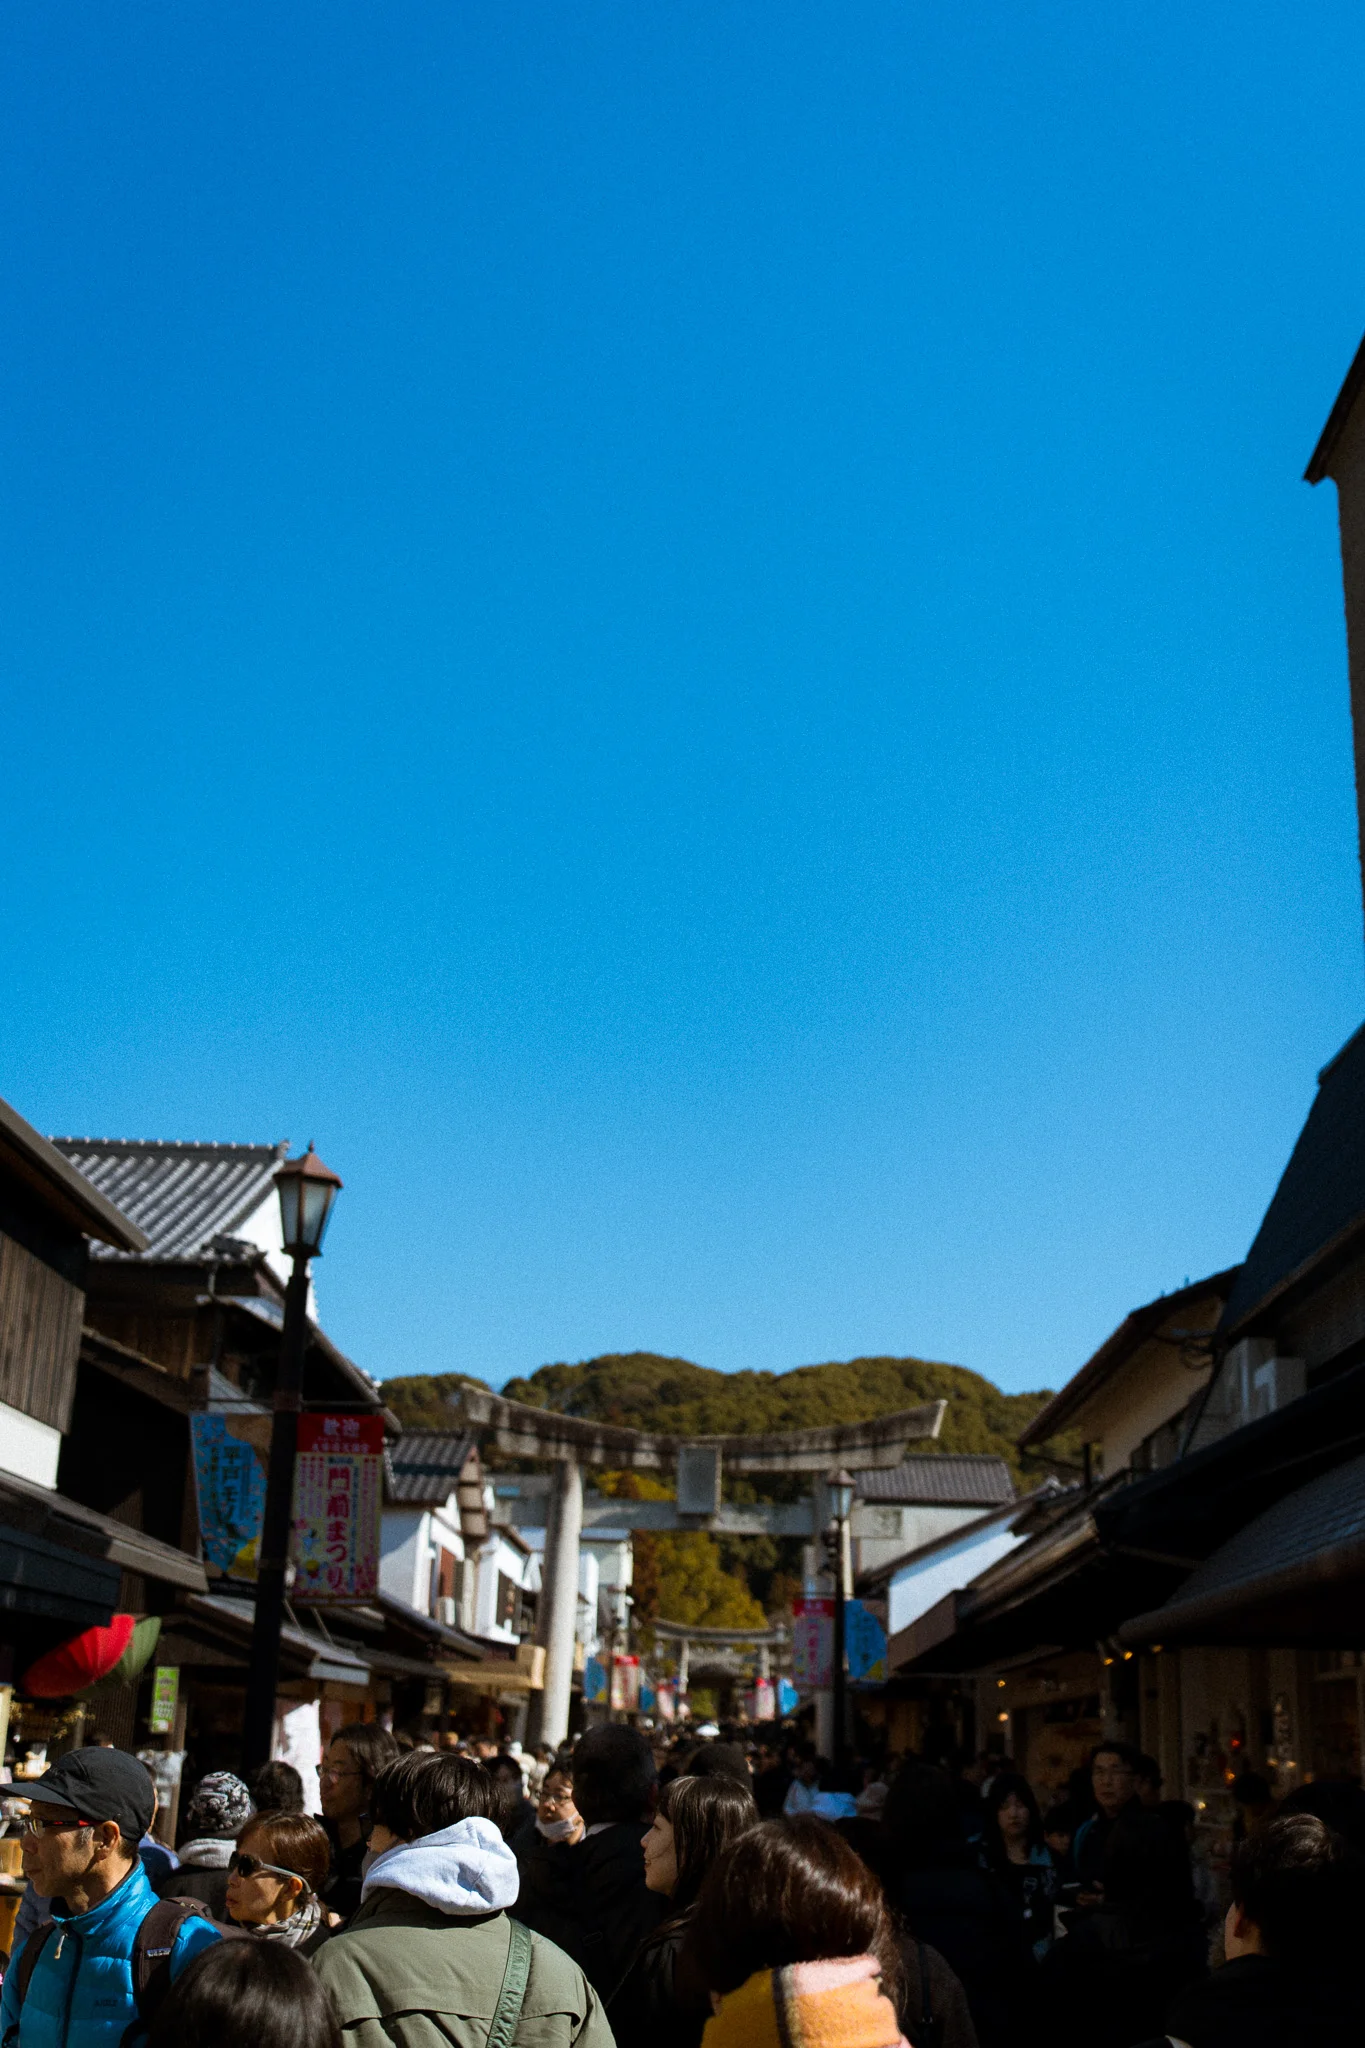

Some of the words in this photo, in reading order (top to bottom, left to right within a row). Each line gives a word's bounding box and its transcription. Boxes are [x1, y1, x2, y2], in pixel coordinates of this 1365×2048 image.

[326, 1465, 350, 1590] 門前まつり
